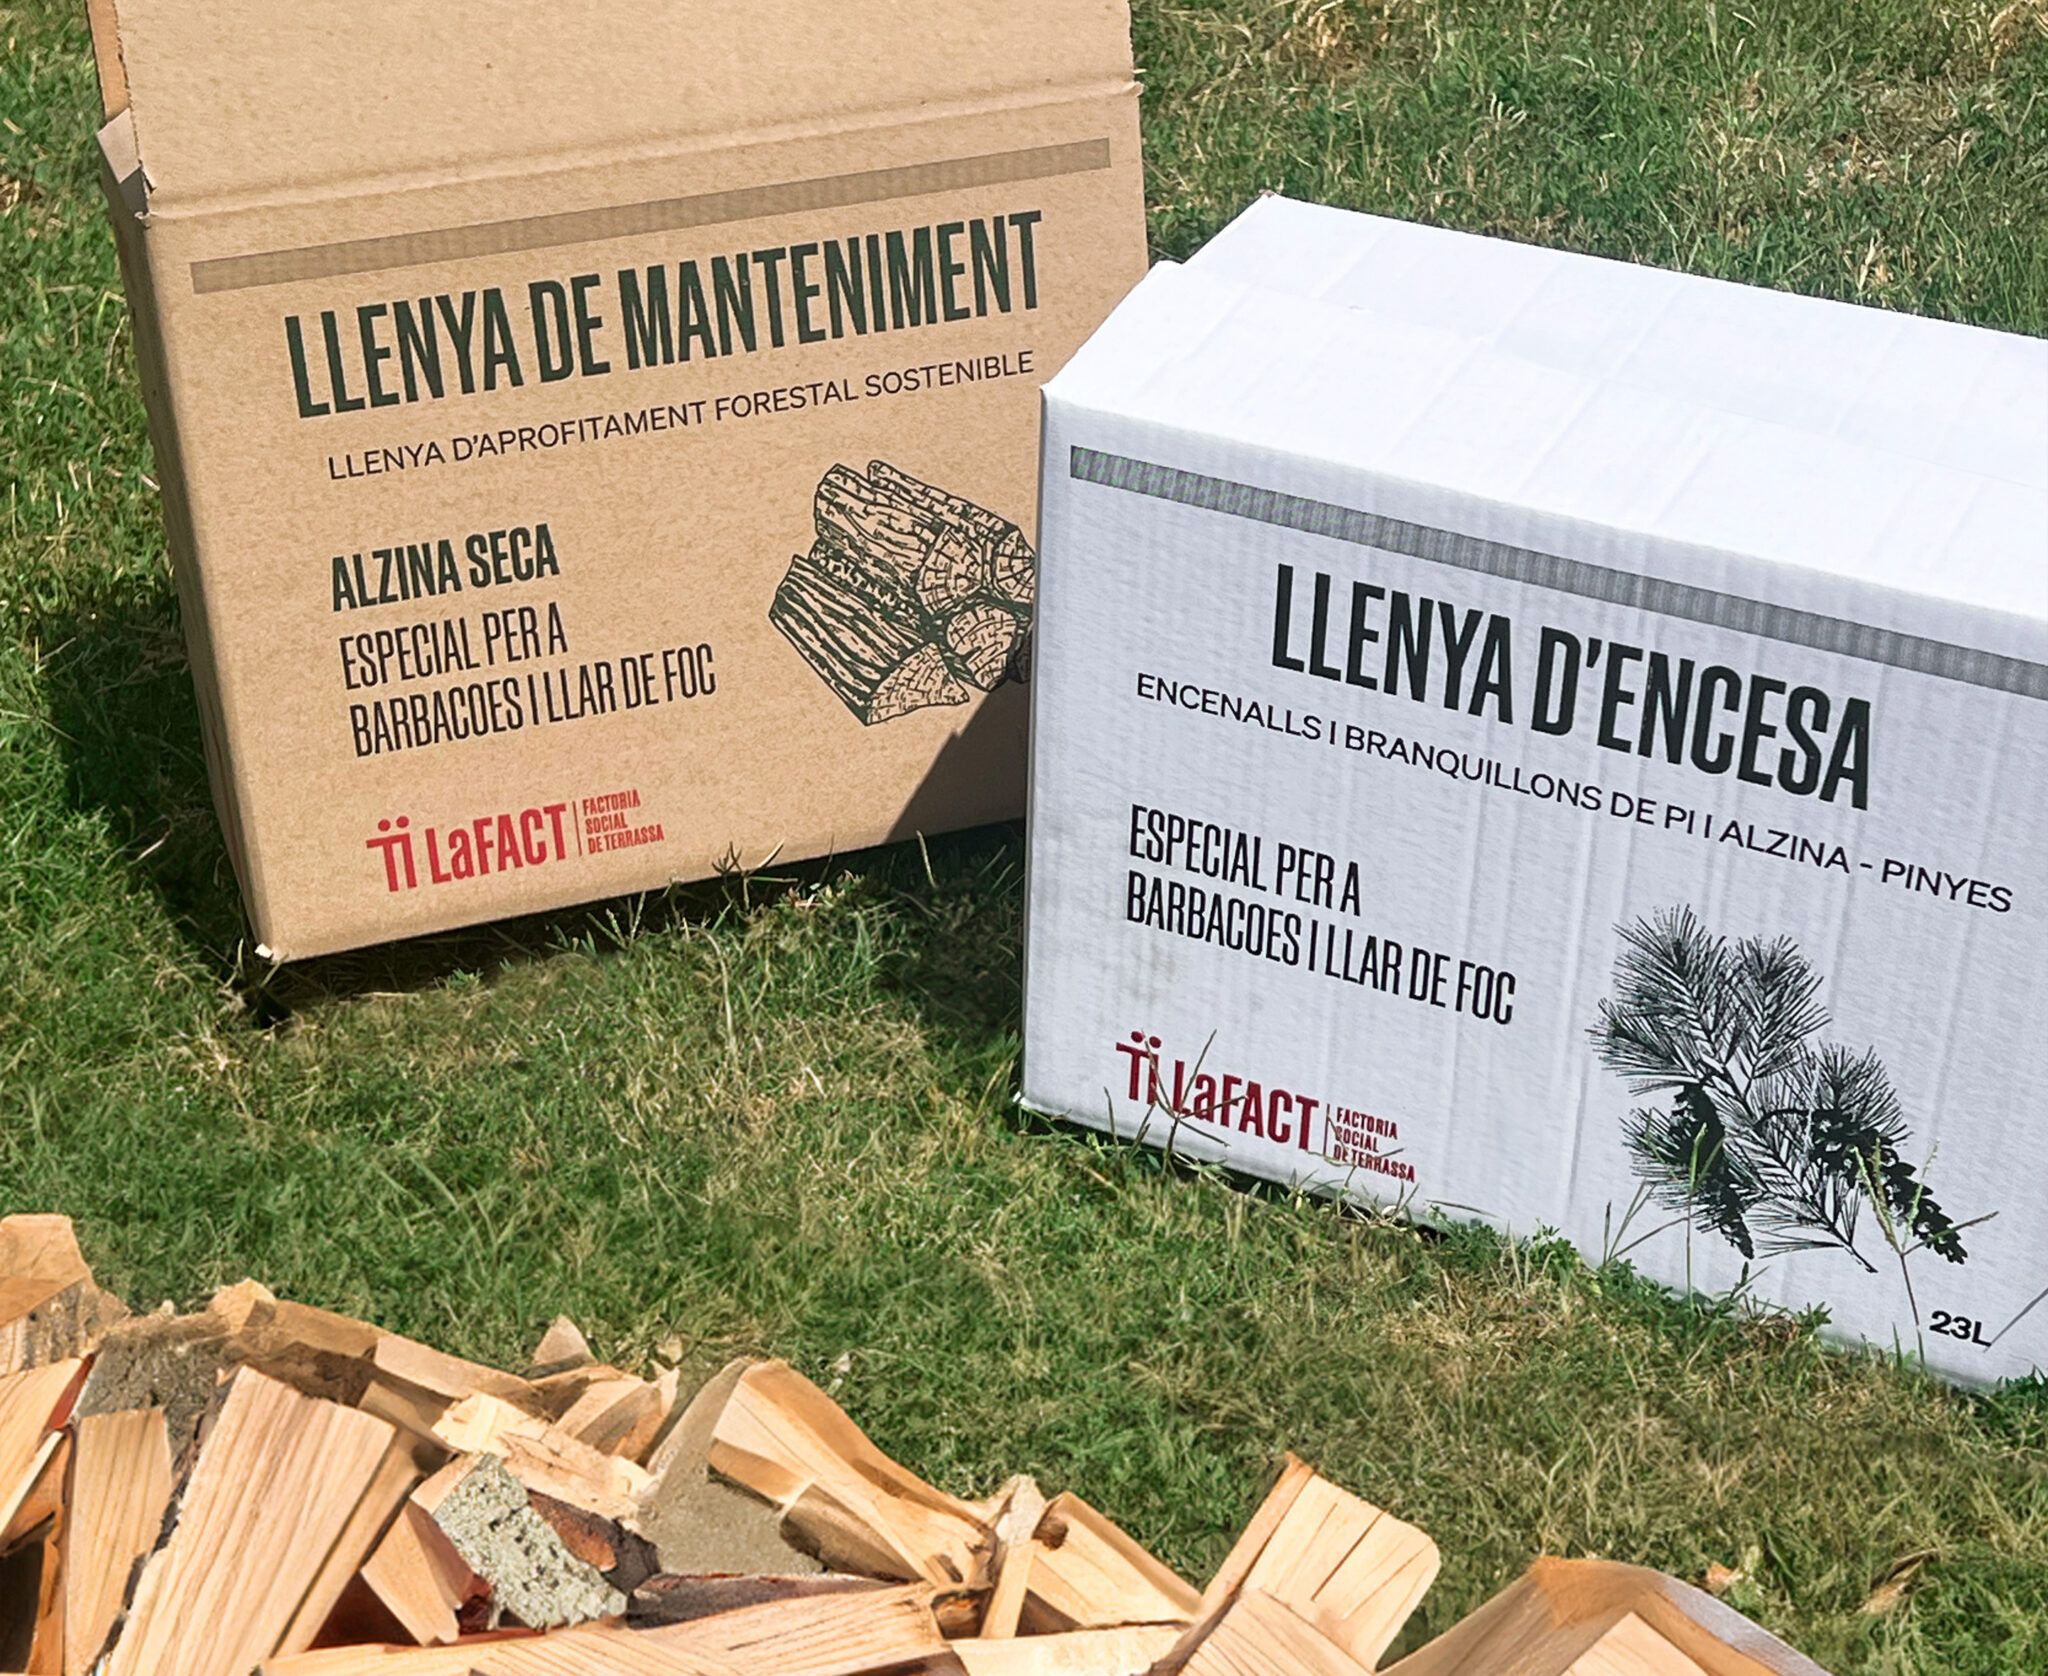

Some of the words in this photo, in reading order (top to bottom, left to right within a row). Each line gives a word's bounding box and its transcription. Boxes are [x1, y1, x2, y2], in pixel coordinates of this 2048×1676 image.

[285, 287, 524, 419] LLENYA
[529, 274, 611, 384] DE
[618, 210, 1042, 371] MANTENIMENT
[328, 441, 446, 480] LLENYA
[451, 402, 707, 463] D'APROFITAMENT
[715, 379, 858, 421] FORESTAL
[865, 351, 1035, 397] SOSTENIBLE
[332, 539, 462, 611] ALZINA
[465, 523, 560, 587] SECA
[339, 617, 480, 690] ESPECIAL
[482, 606, 541, 665] PER
[548, 601, 568, 655] A
[1271, 563, 1513, 725] LLENYA
[1531, 625, 1871, 811] D'ENCESA
[350, 677, 523, 757] BARBACOES
[528, 675, 539, 725] I
[543, 661, 617, 723] LLAR
[621, 654, 660, 709] DE
[662, 643, 716, 701] FOC
[582, 790, 641, 816] FACTORIA
[585, 812, 628, 834] SOCIAL
[1136, 673, 1323, 742] ENCENALLS
[1328, 720, 1337, 743] I
[1343, 726, 1602, 812] BRANQUILLONS
[1610, 793, 1656, 825] DE
[1664, 808, 1696, 834] PI
[1704, 813, 1712, 837] I
[1719, 820, 1850, 874] ALZINA
[1881, 859, 2013, 914] PINYES
[425, 803, 568, 885] LaFACT
[588, 837, 604, 854] DE
[605, 824, 665, 851] TERRASSA
[1129, 804, 1267, 892] ESPECIAL
[1275, 843, 1334, 908] PER
[1341, 861, 1361, 916] A
[1127, 870, 1300, 966] BARBACOES
[1308, 919, 1318, 971] I
[1325, 924, 1402, 995] LLAR
[1409, 947, 1450, 1008] DE
[1455, 960, 1516, 1024] FOC
[1172, 1059, 1319, 1151] LaFACT
[1335, 1126, 1379, 1152] SOCIAL
[1336, 1107, 1398, 1140] FACTORIA
[1333, 1146, 1350, 1162] DE
[1351, 1150, 1415, 1182] TERRASSA
[1929, 1310, 1992, 1347] 23L
